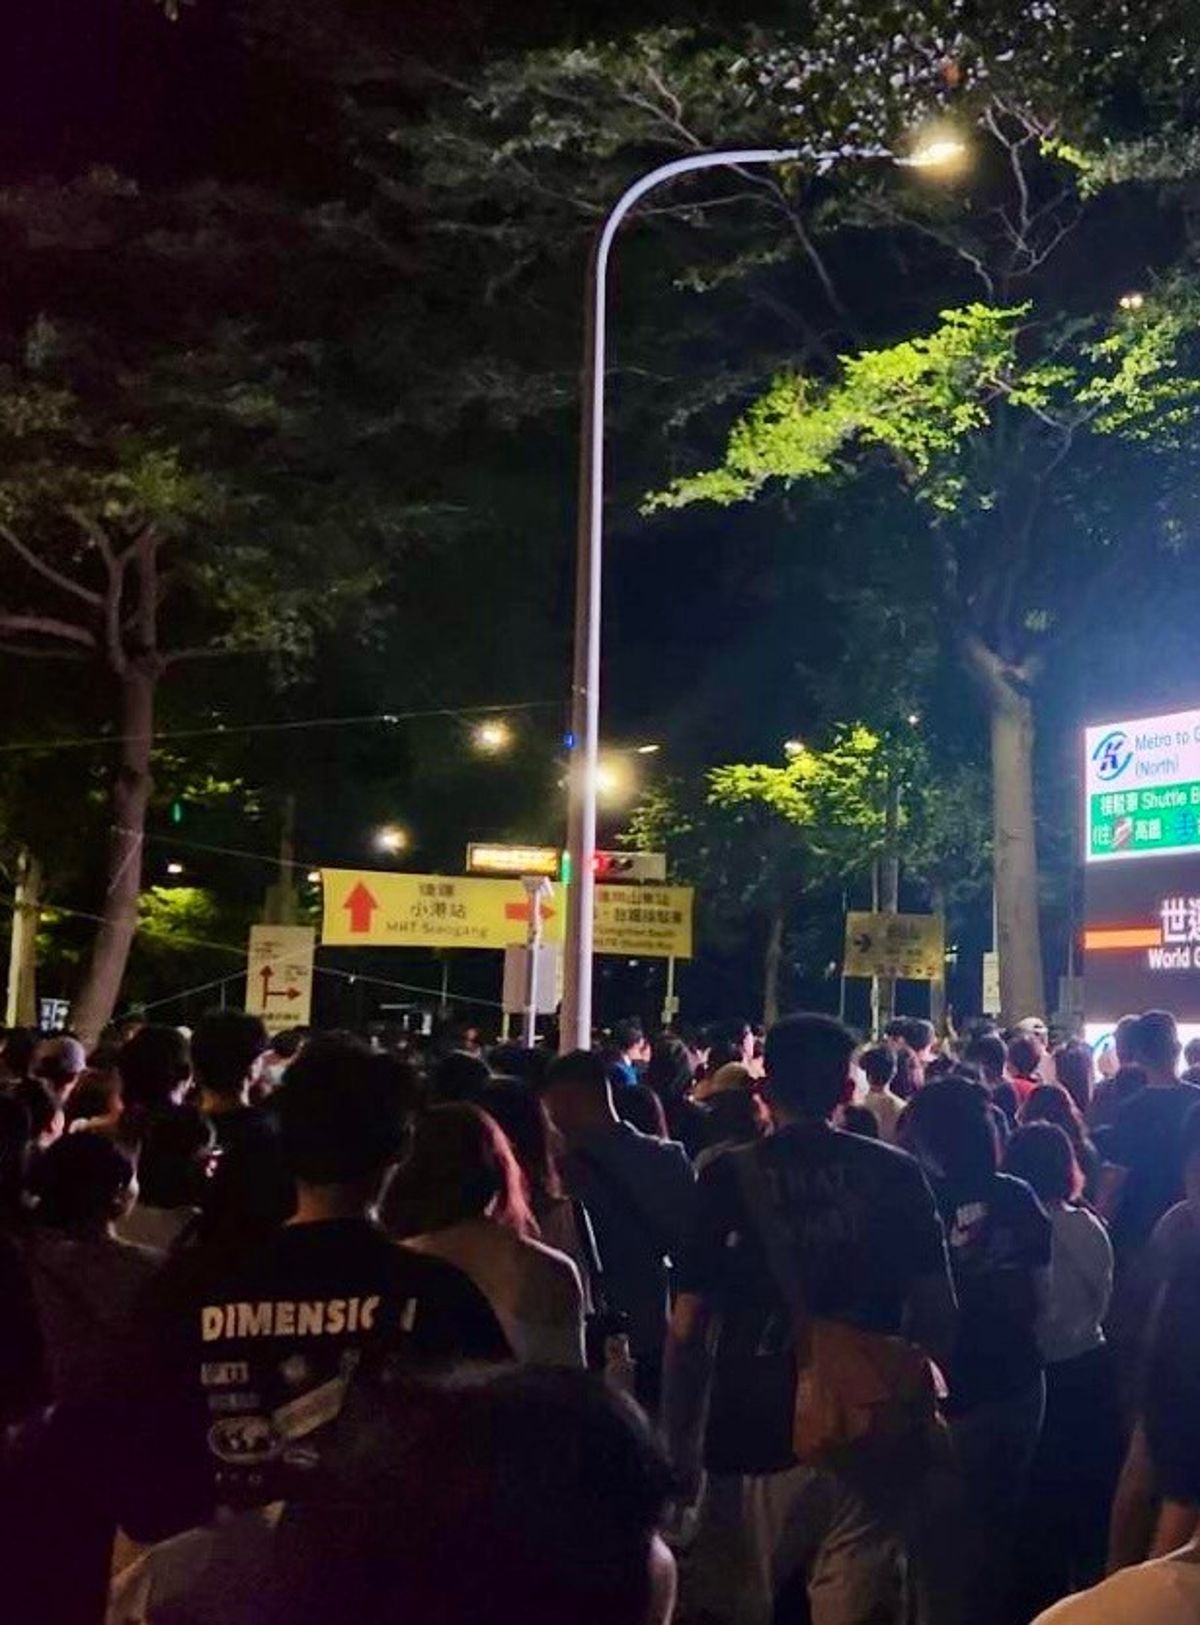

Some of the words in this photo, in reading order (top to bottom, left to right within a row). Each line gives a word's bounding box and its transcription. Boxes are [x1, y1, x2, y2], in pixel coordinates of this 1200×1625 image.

[1135, 734, 1172, 750] Metro
[1176, 732, 1190, 746] to
[1135, 755, 1179, 777] (North)
[1141, 788, 1188, 811] Shuttle
[1148, 946, 1190, 969] World
